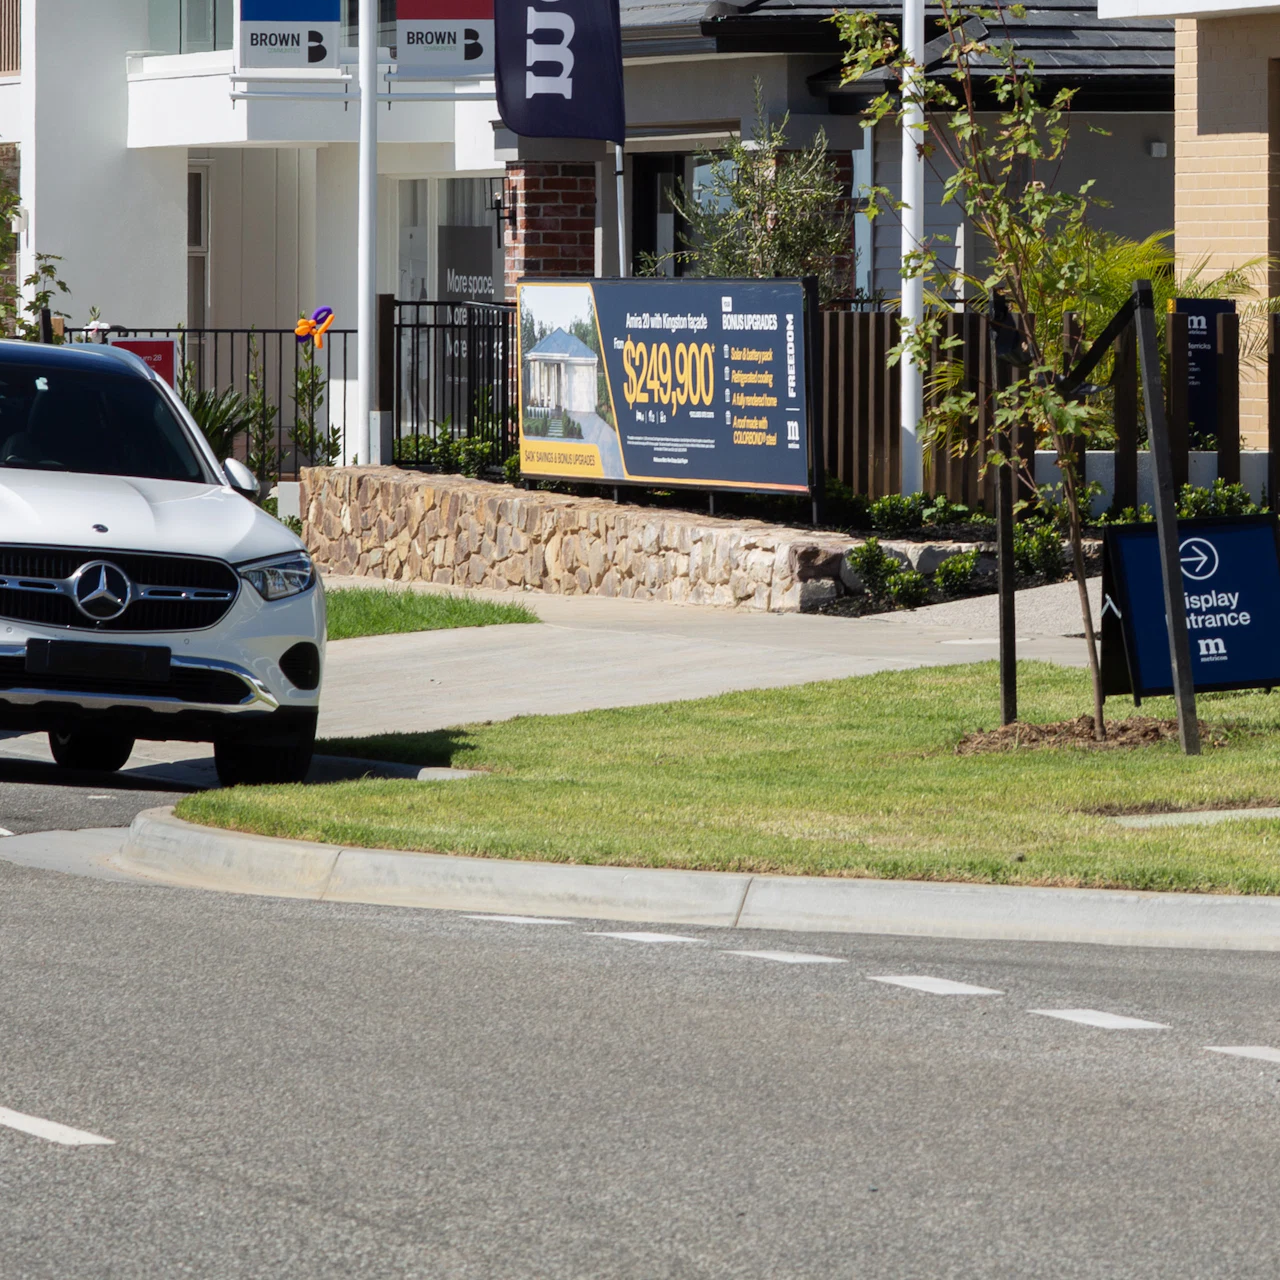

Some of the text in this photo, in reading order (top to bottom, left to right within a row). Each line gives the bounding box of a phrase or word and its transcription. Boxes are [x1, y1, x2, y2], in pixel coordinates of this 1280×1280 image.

[250, 32, 300, 47] BROWN
[407, 31, 457, 45] BROWN
[447, 268, 467, 293] More
[722, 314, 778, 330] BONUS UPGRADES
[786, 314, 796, 398] FREEDOM
[1184, 589, 1239, 612] isplay
[1186, 611, 1251, 630] trance
[1198, 637, 1227, 655] m
